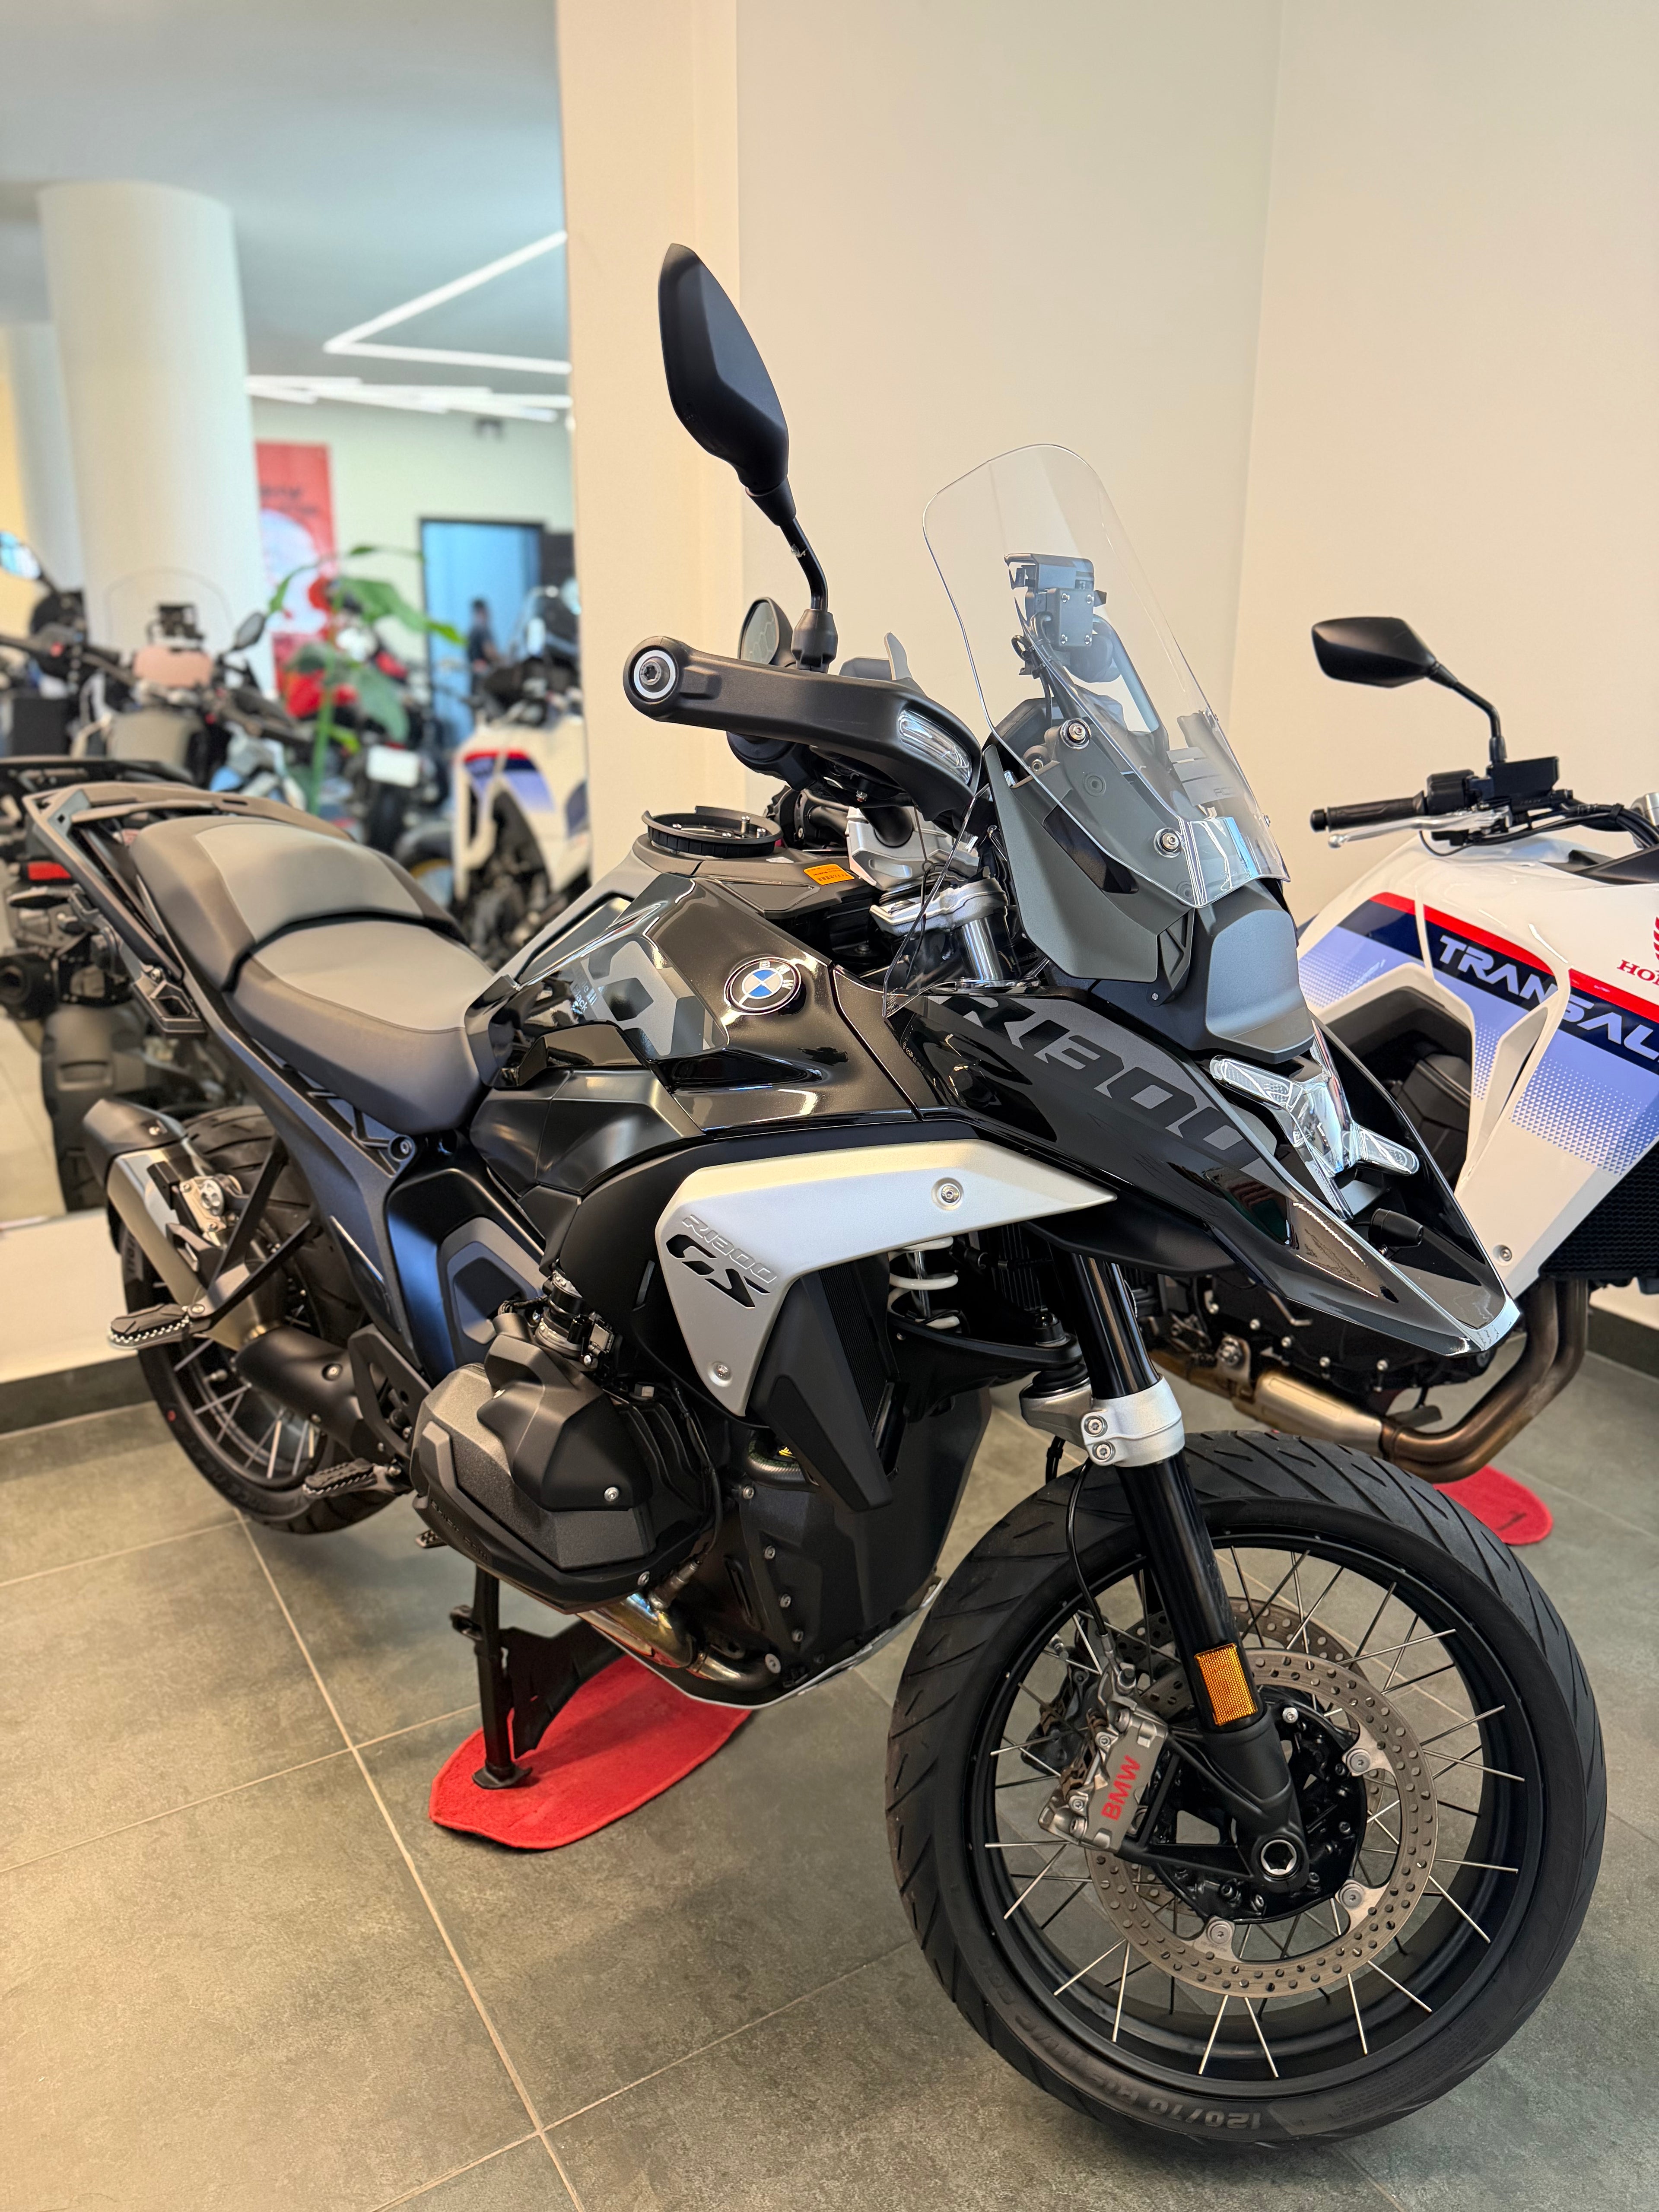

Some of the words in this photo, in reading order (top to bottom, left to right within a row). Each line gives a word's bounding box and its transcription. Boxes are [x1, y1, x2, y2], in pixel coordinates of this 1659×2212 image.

[759, 960, 794, 990] BMW
[1440, 934, 1659, 1060] TRANSAL
[666, 1234, 771, 1309] GS
[682, 1214, 777, 1284] R1300
[1101, 1754, 1141, 1821] BMW
[1147, 2098, 1261, 2129] 120/70
